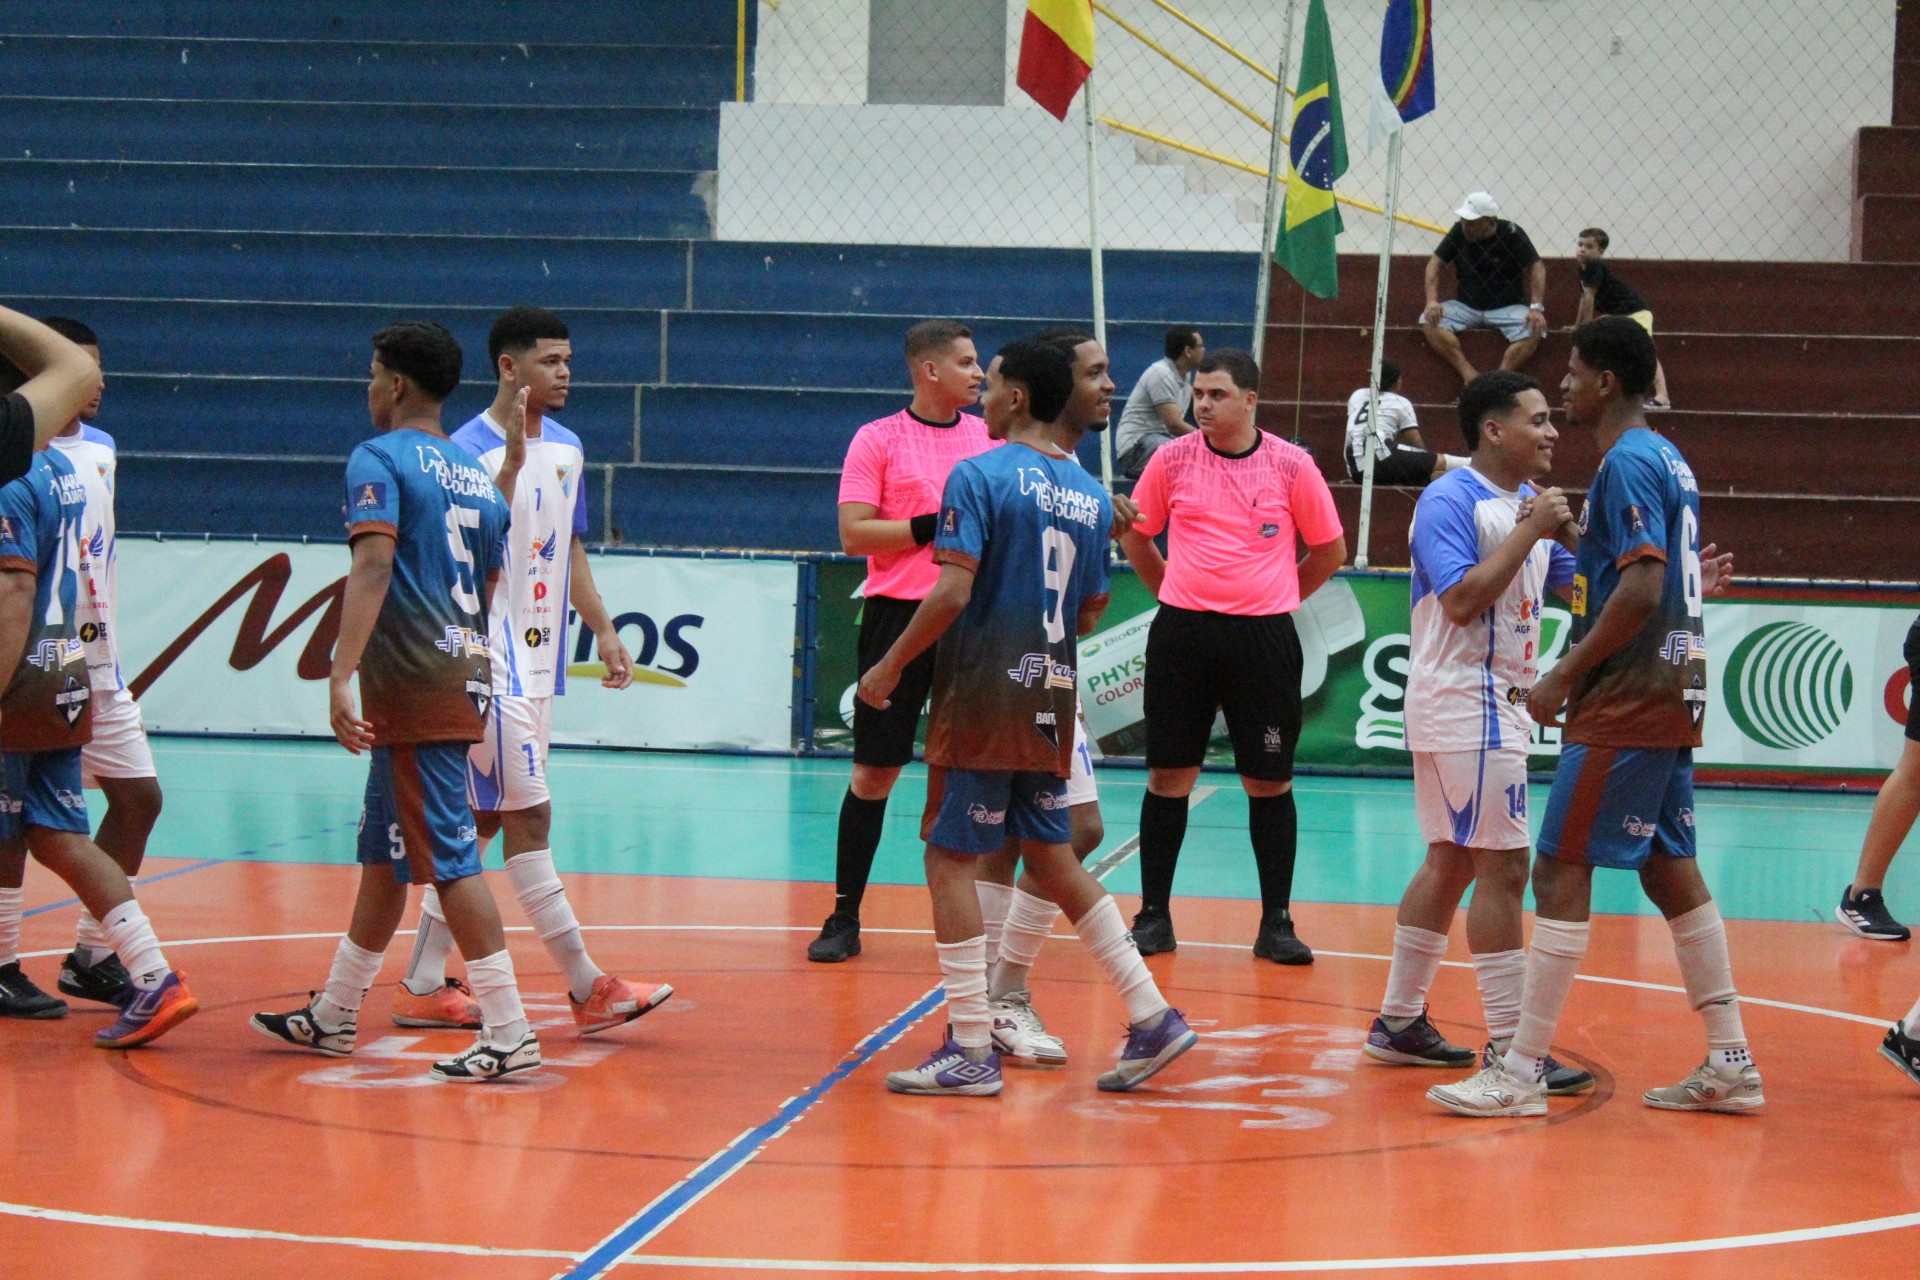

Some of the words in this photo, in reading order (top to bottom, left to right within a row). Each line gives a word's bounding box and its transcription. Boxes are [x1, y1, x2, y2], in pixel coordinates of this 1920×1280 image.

[1054, 486, 1099, 514] HARAS
[1055, 502, 1098, 529] DUARTE
[445, 503, 481, 616] 5
[1680, 504, 1703, 618] 6
[1042, 526, 1077, 644] 9
[1086, 654, 1146, 693] PHYS
[1095, 677, 1144, 706] COLOR
[522, 743, 536, 777] 1
[1504, 783, 1526, 818] 14
[388, 822, 406, 860] 5
